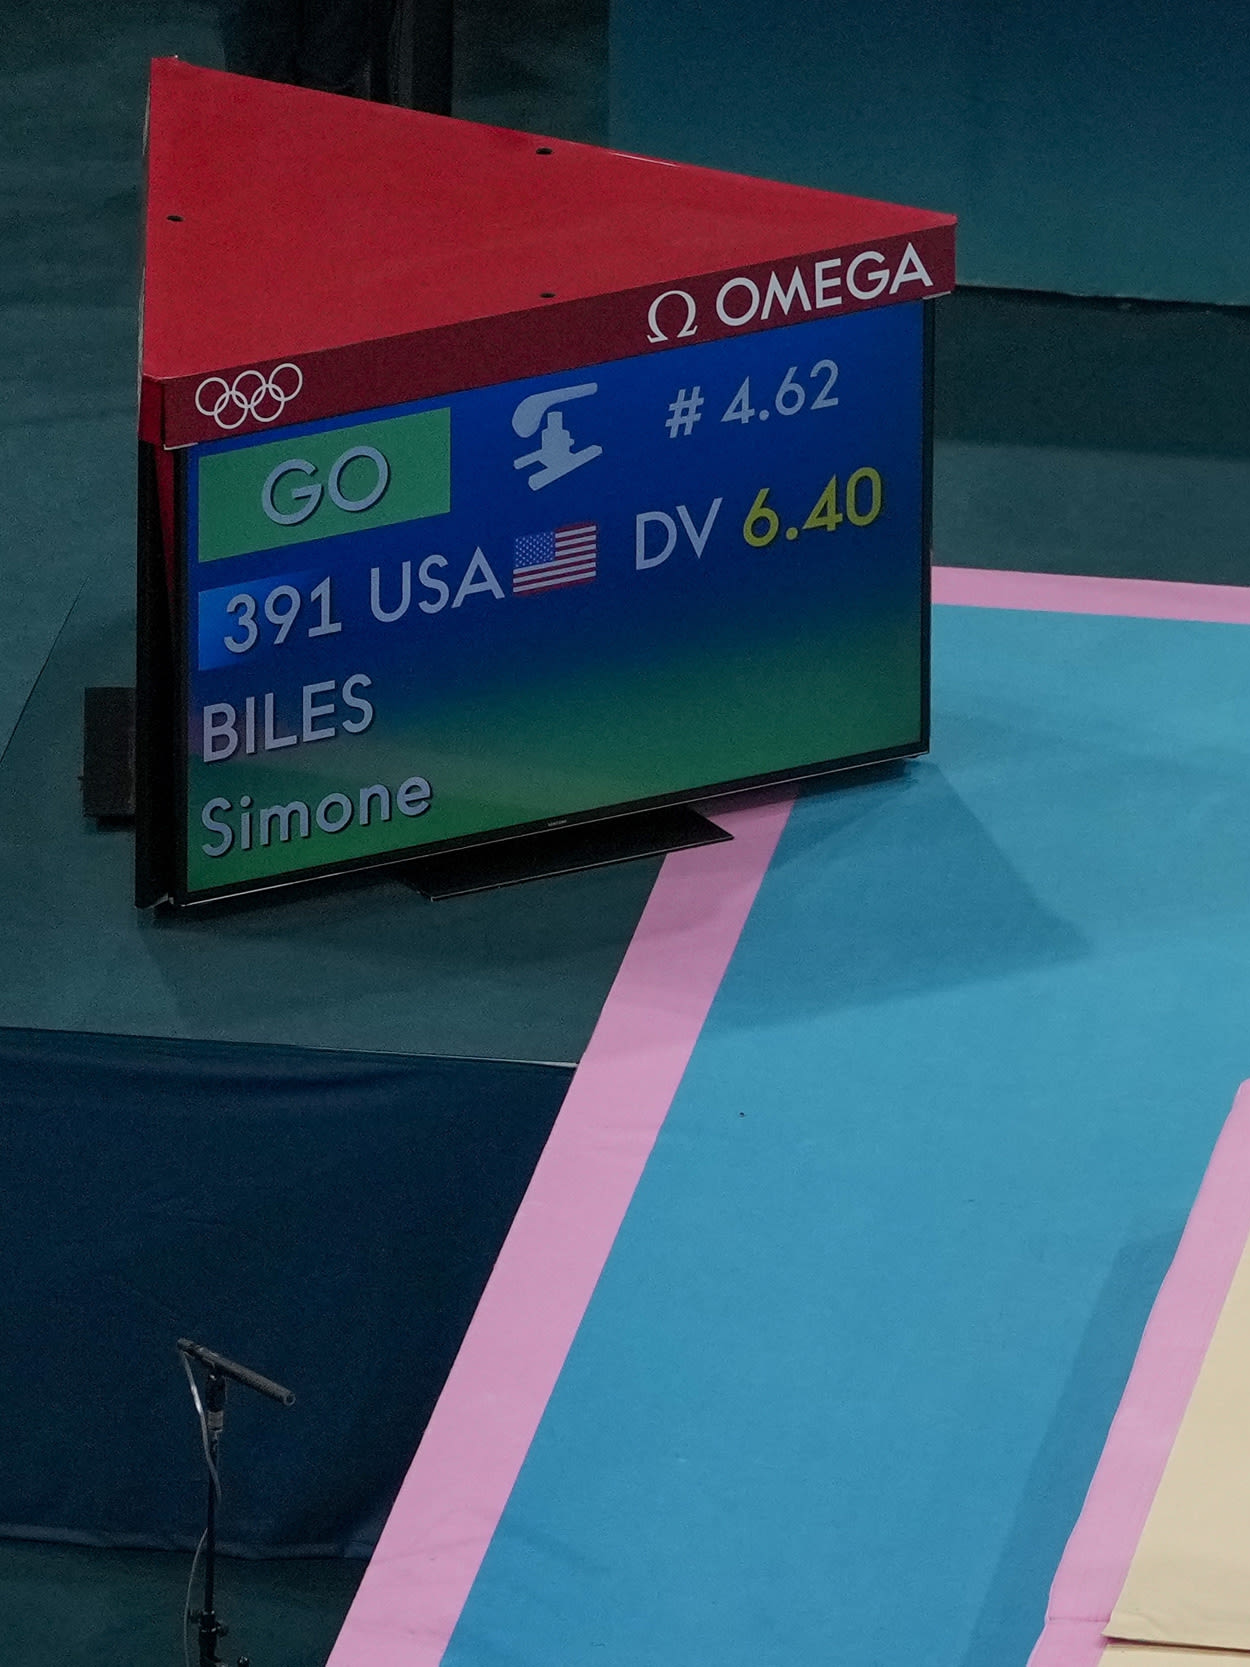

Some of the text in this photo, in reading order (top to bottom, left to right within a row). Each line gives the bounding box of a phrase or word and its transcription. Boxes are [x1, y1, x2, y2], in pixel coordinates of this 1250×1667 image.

[715, 242, 934, 326] OMEGA
[720, 359, 839, 424] 4.62
[261, 445, 390, 526] GO
[635, 466, 883, 571] DV 6.40
[223, 546, 506, 653] 391 USA
[203, 673, 374, 763] BILES
[202, 776, 432, 857] Simone
